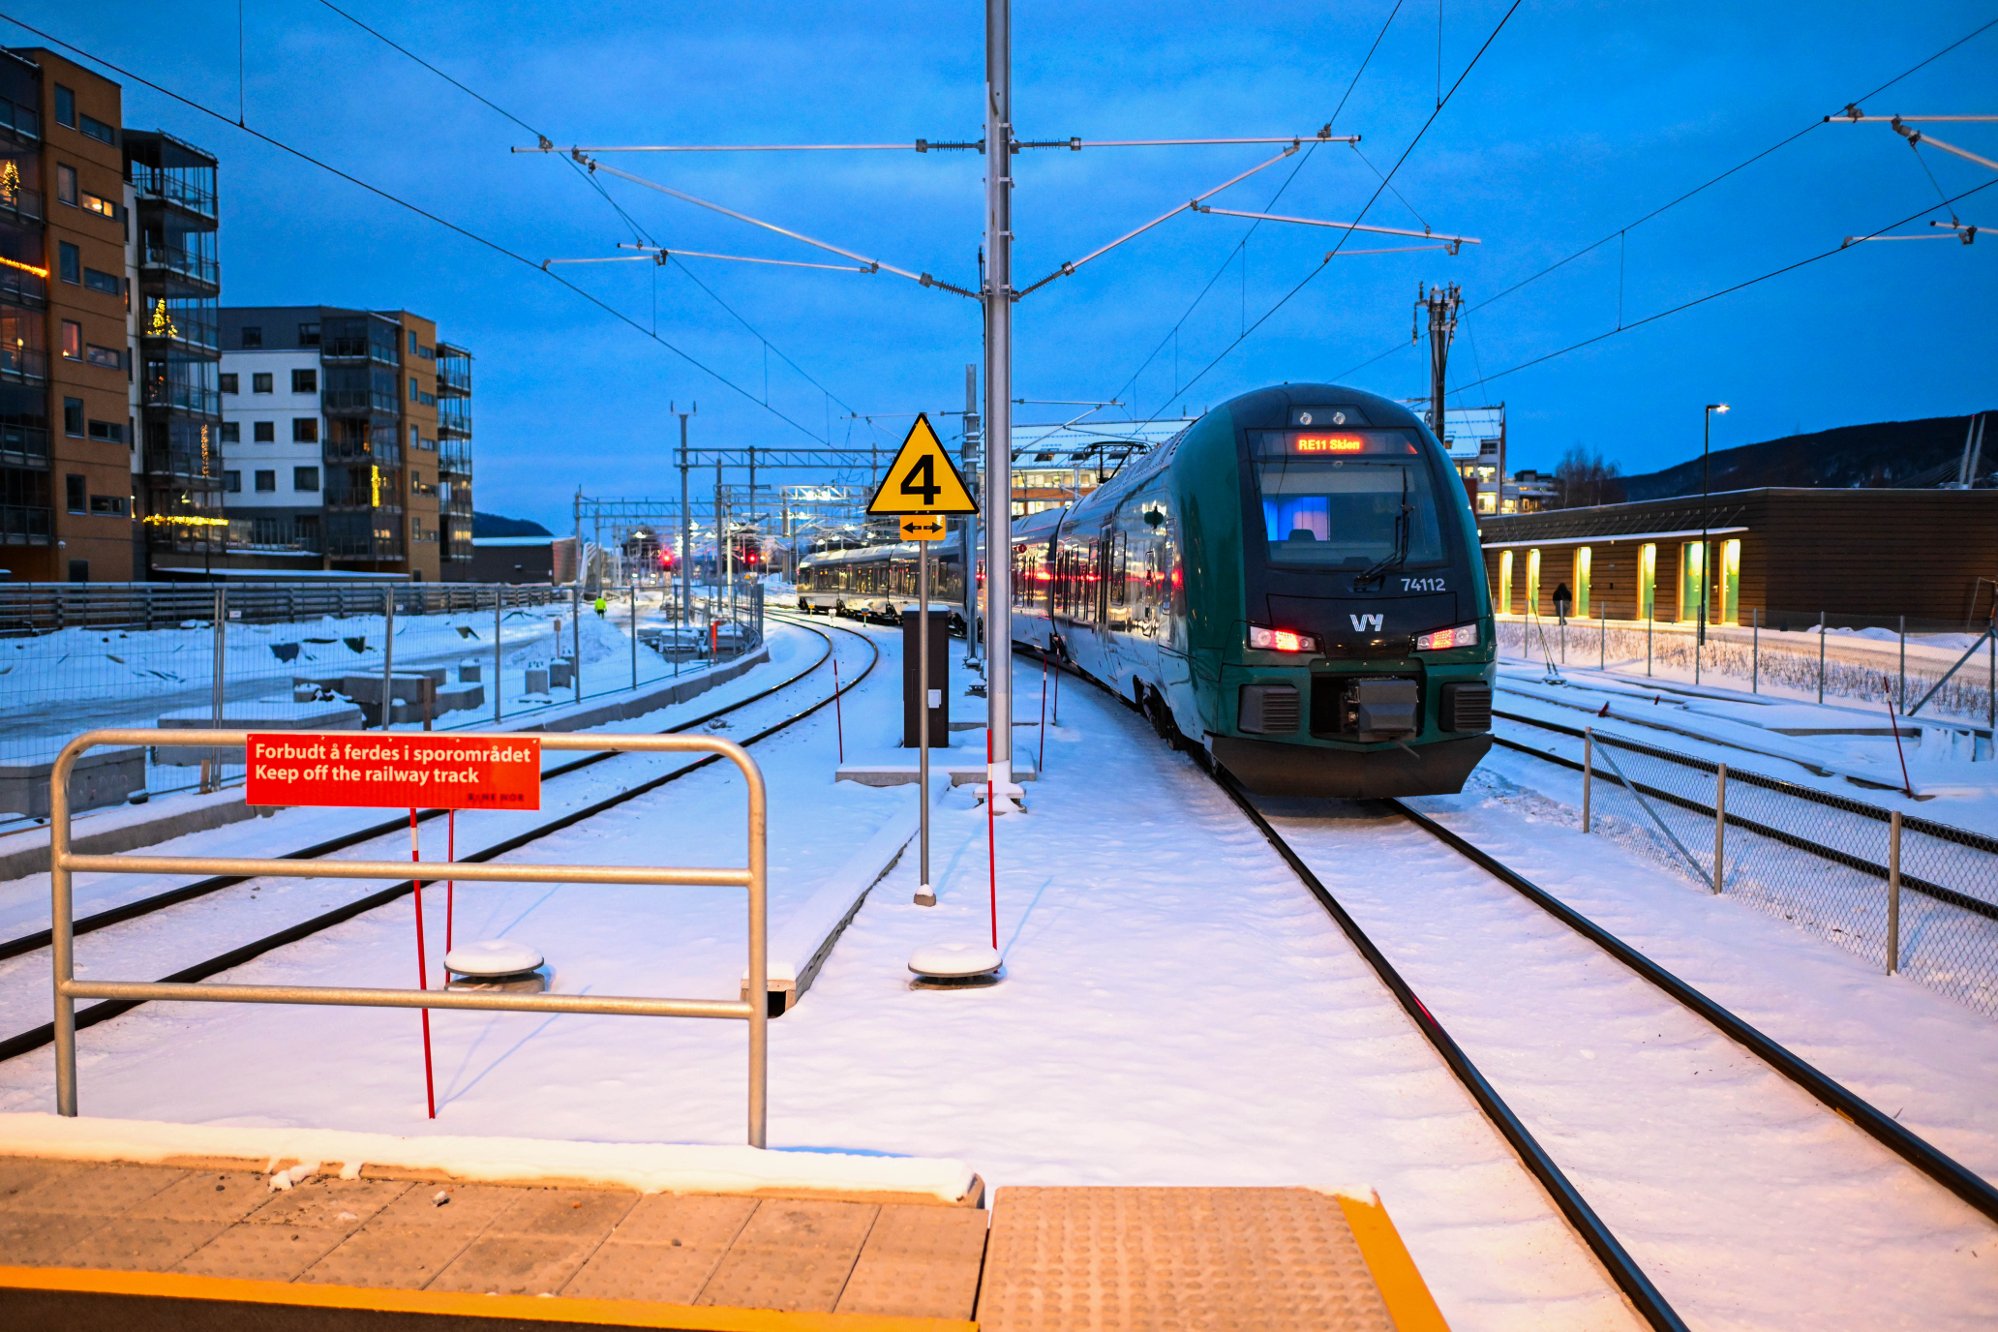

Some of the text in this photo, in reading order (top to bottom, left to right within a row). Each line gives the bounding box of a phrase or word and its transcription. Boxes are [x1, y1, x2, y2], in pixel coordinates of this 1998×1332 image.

[1299, 439, 1327, 450] RE11
[900, 454, 942, 505] 4
[1400, 578, 1446, 592] 74112
[255, 743, 531, 765] Forbudt å ferdes i sporområdet
[255, 764, 480, 787] Keep off the railway track
